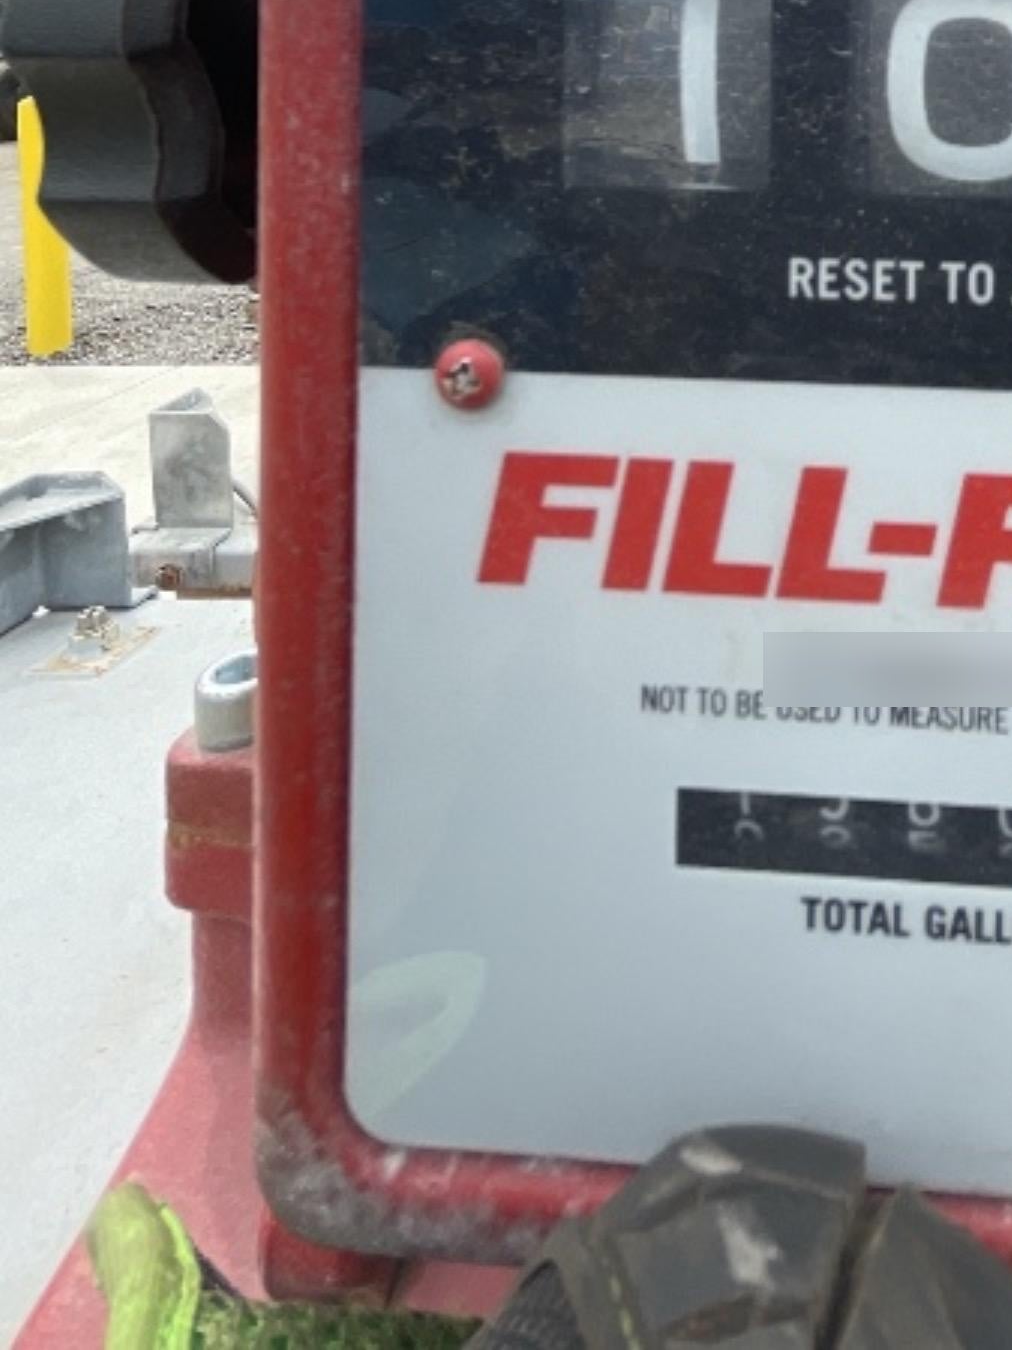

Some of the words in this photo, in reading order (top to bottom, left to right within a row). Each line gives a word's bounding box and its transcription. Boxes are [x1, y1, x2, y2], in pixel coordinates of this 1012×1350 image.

[788, 257, 925, 302] RESET
[939, 261, 995, 306] TO
[640, 684, 688, 714] NOT
[696, 688, 728, 717] TO
[735, 690, 767, 721] BE
[889, 706, 1008, 735] MEASURE
[801, 896, 909, 938] TOTAL
